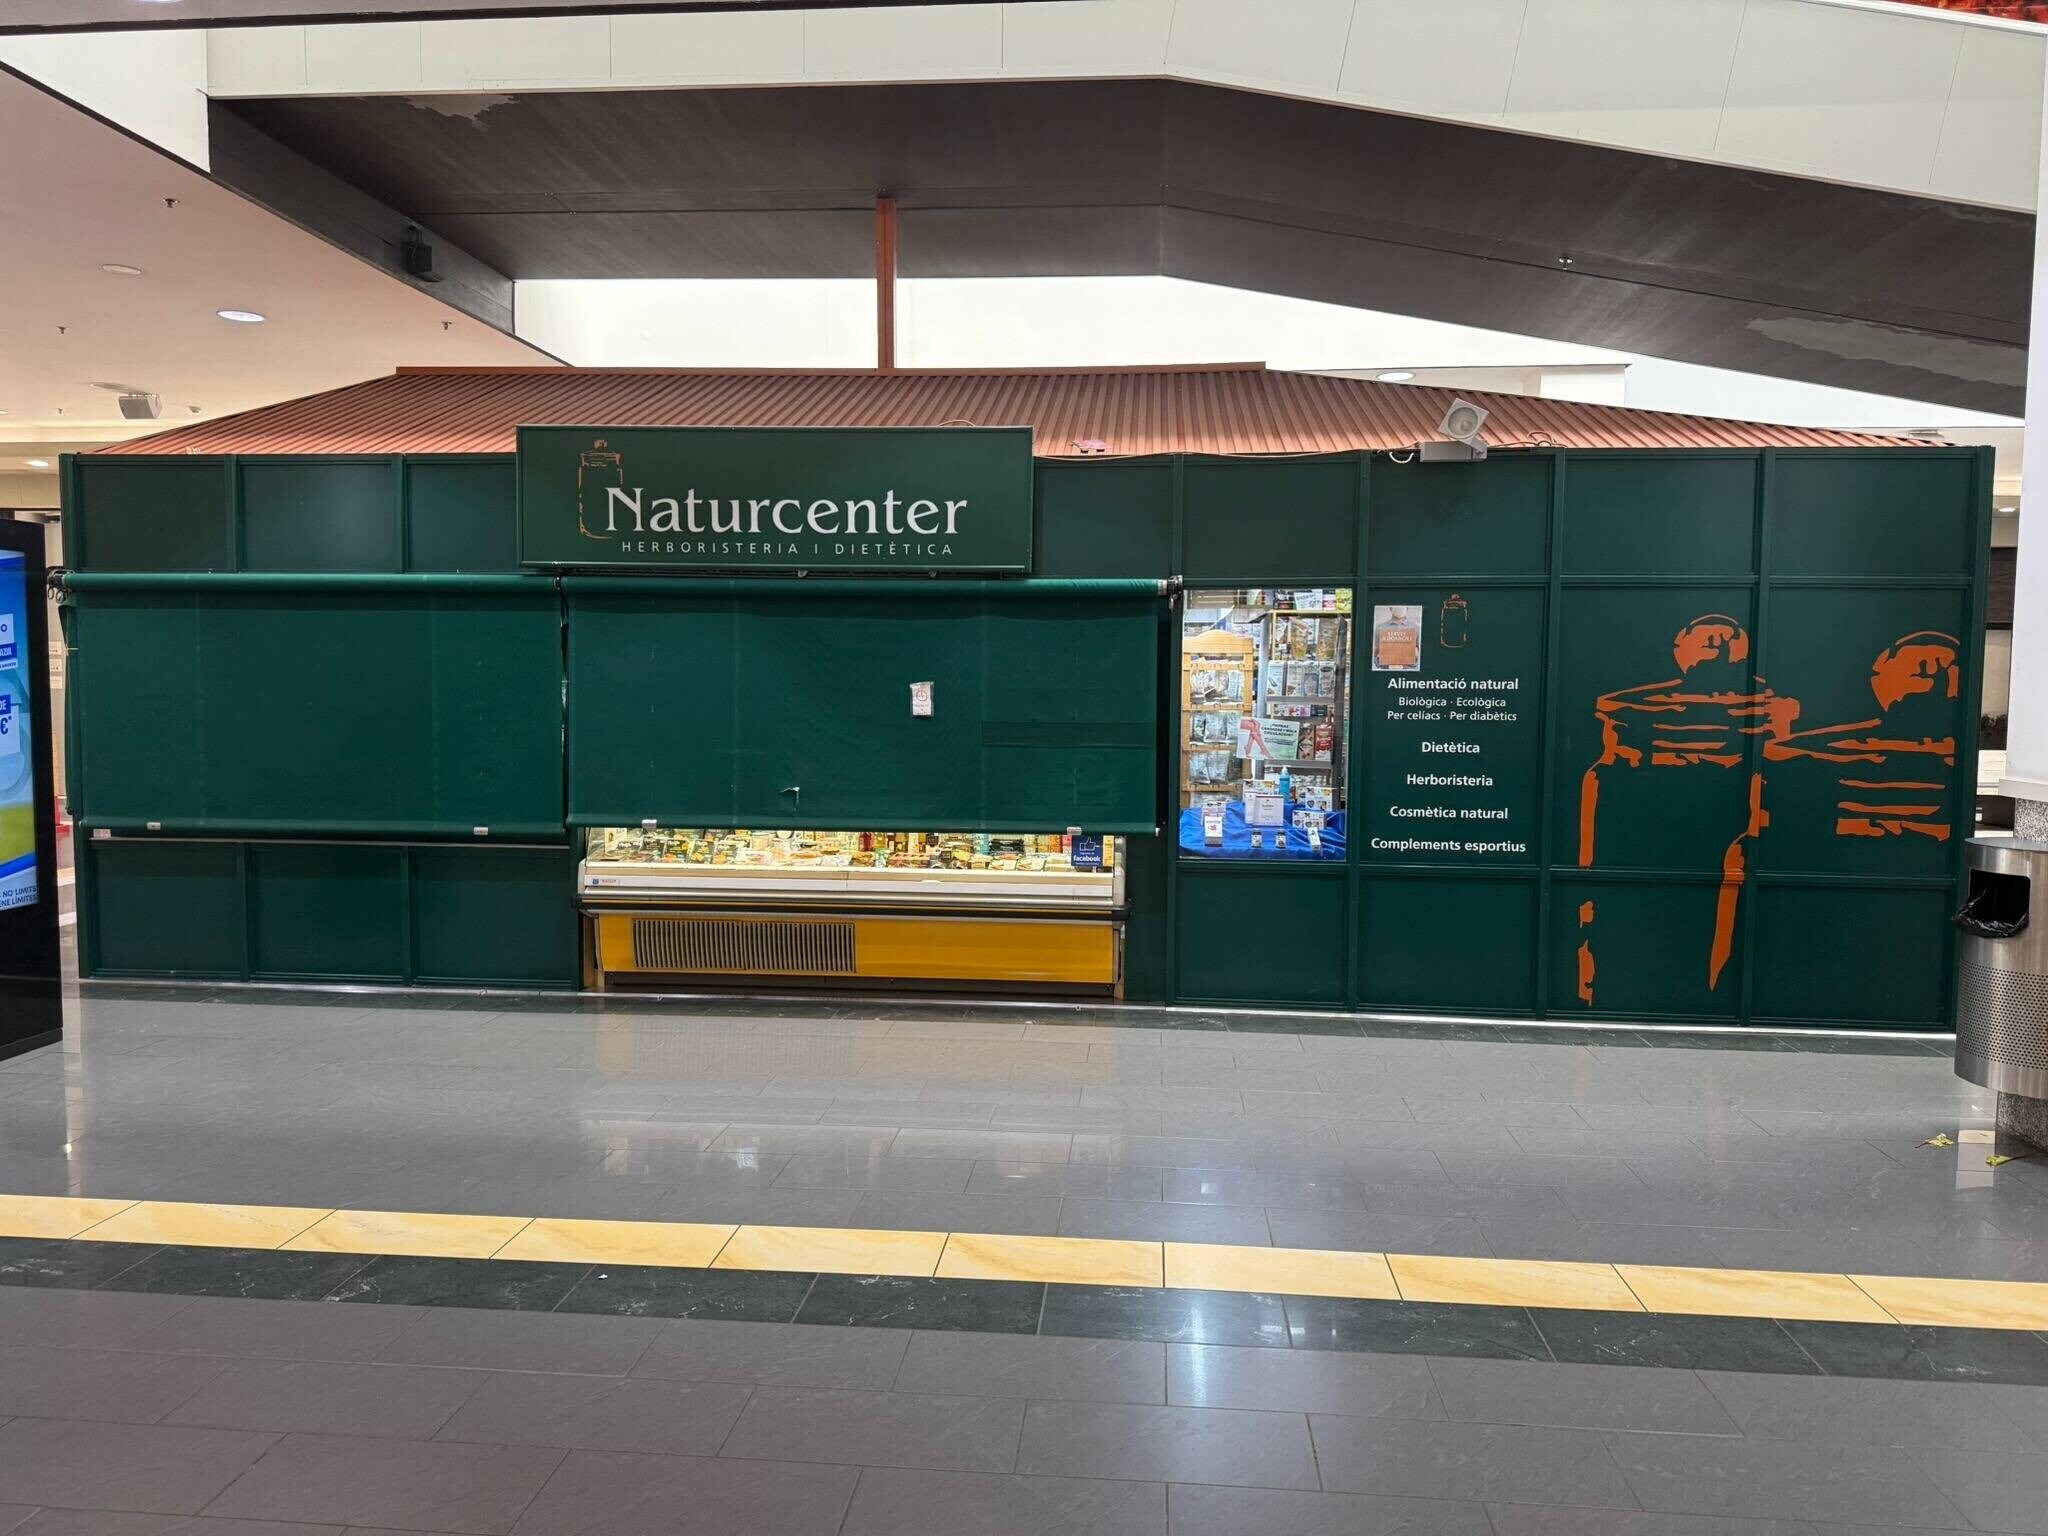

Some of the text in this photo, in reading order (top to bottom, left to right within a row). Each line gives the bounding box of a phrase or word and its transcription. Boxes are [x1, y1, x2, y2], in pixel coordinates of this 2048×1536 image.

[605, 485, 968, 535] Naturcenter
[621, 541, 953, 556] HERBORISTERIA I DIETÈTICA
[1388, 678, 1519, 690] Alimentació natural
[1398, 697, 1506, 709] Biològica Ecològica
[1387, 711, 1517, 721] Per celíacs Per diabètics
[1421, 741, 1481, 753] Dietètica
[1406, 774, 1493, 786] Herboristeria
[1390, 806, 1509, 819] Cosmètica natural
[1370, 838, 1527, 853] Complements esportius
[1073, 854, 1101, 862] facebook
[2, 890, 13, 898] NO
